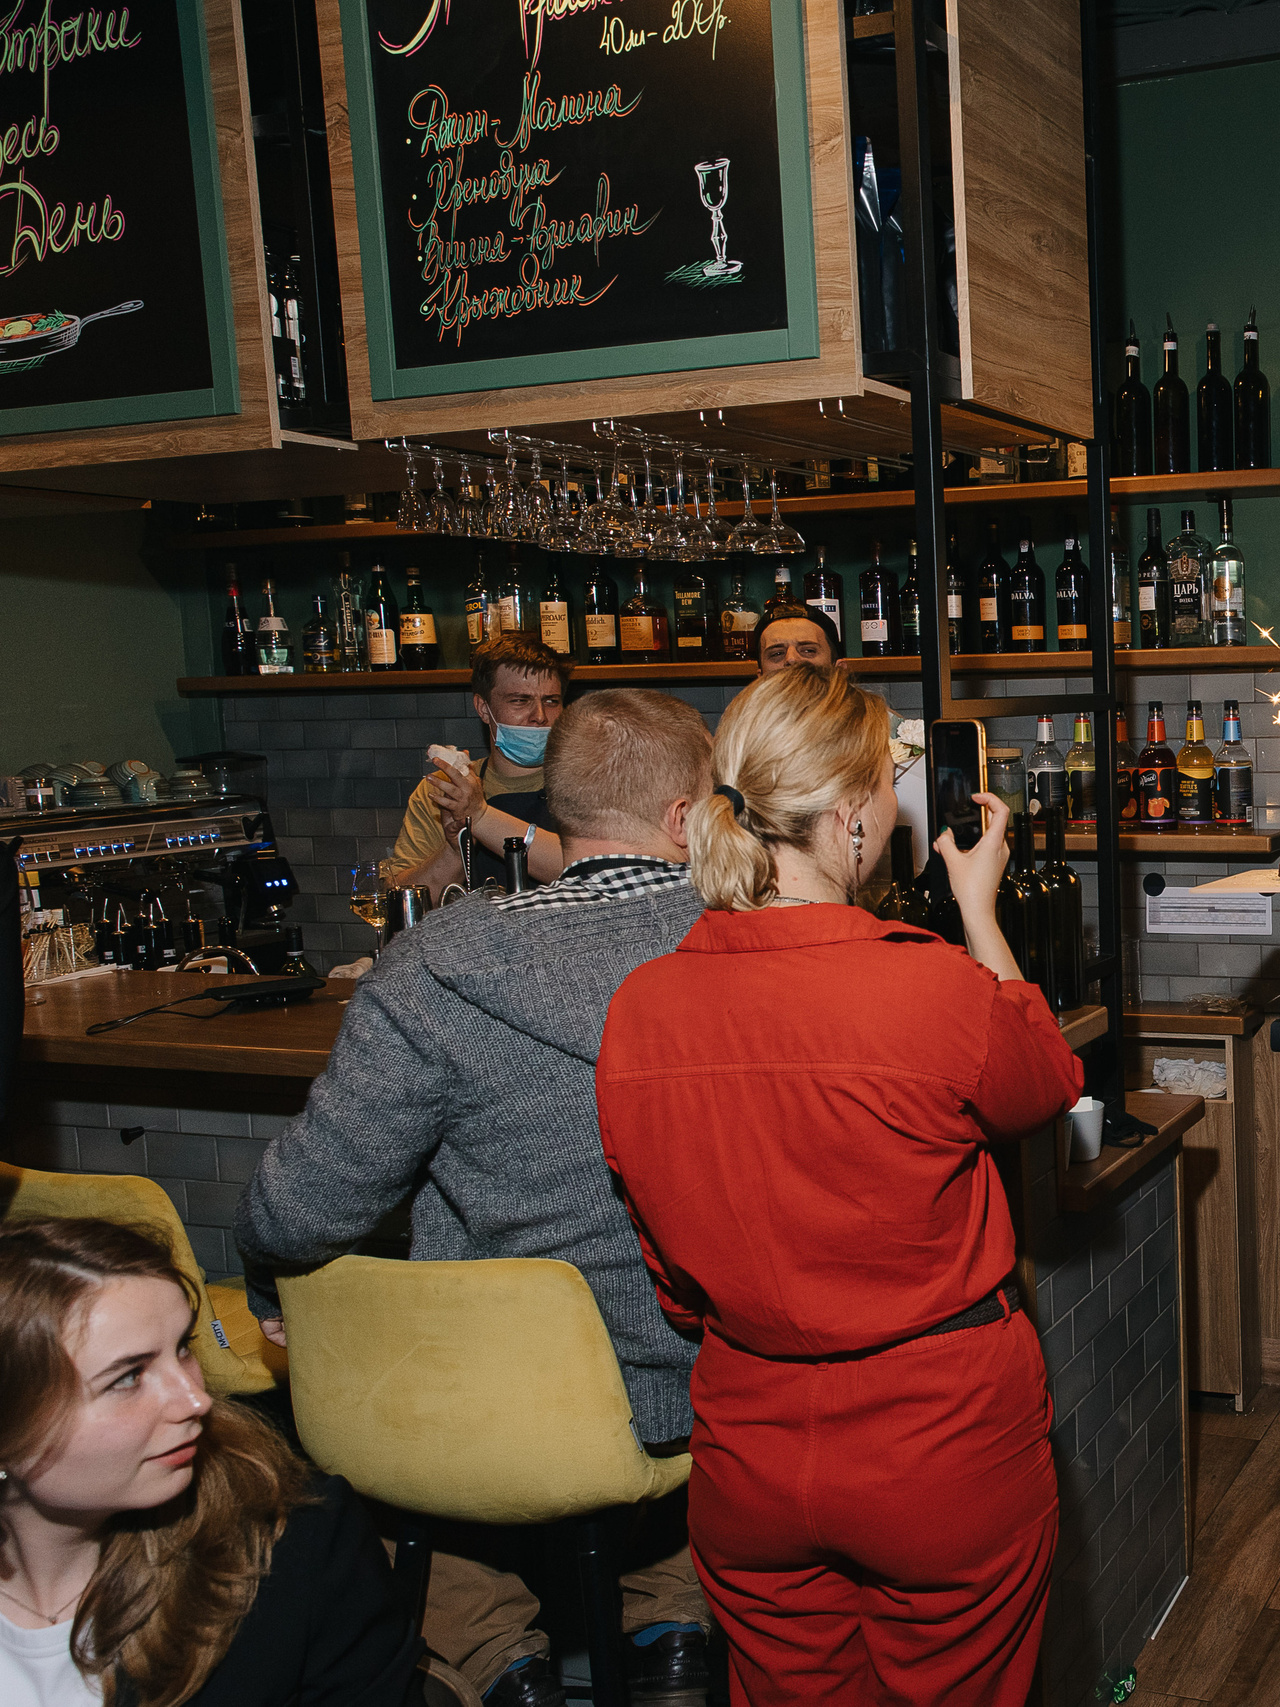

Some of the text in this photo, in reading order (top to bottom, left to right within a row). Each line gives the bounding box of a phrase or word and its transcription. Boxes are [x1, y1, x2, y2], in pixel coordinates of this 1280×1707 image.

[0, 113, 61, 178] есь
[0, 166, 126, 278] День
[419, 252, 619, 348] Крыжовник
[674, 590, 701, 600] TULLAMORE
[1011, 592, 1035, 600] DALVA
[1173, 583, 1199, 598] ЦАРЬ
